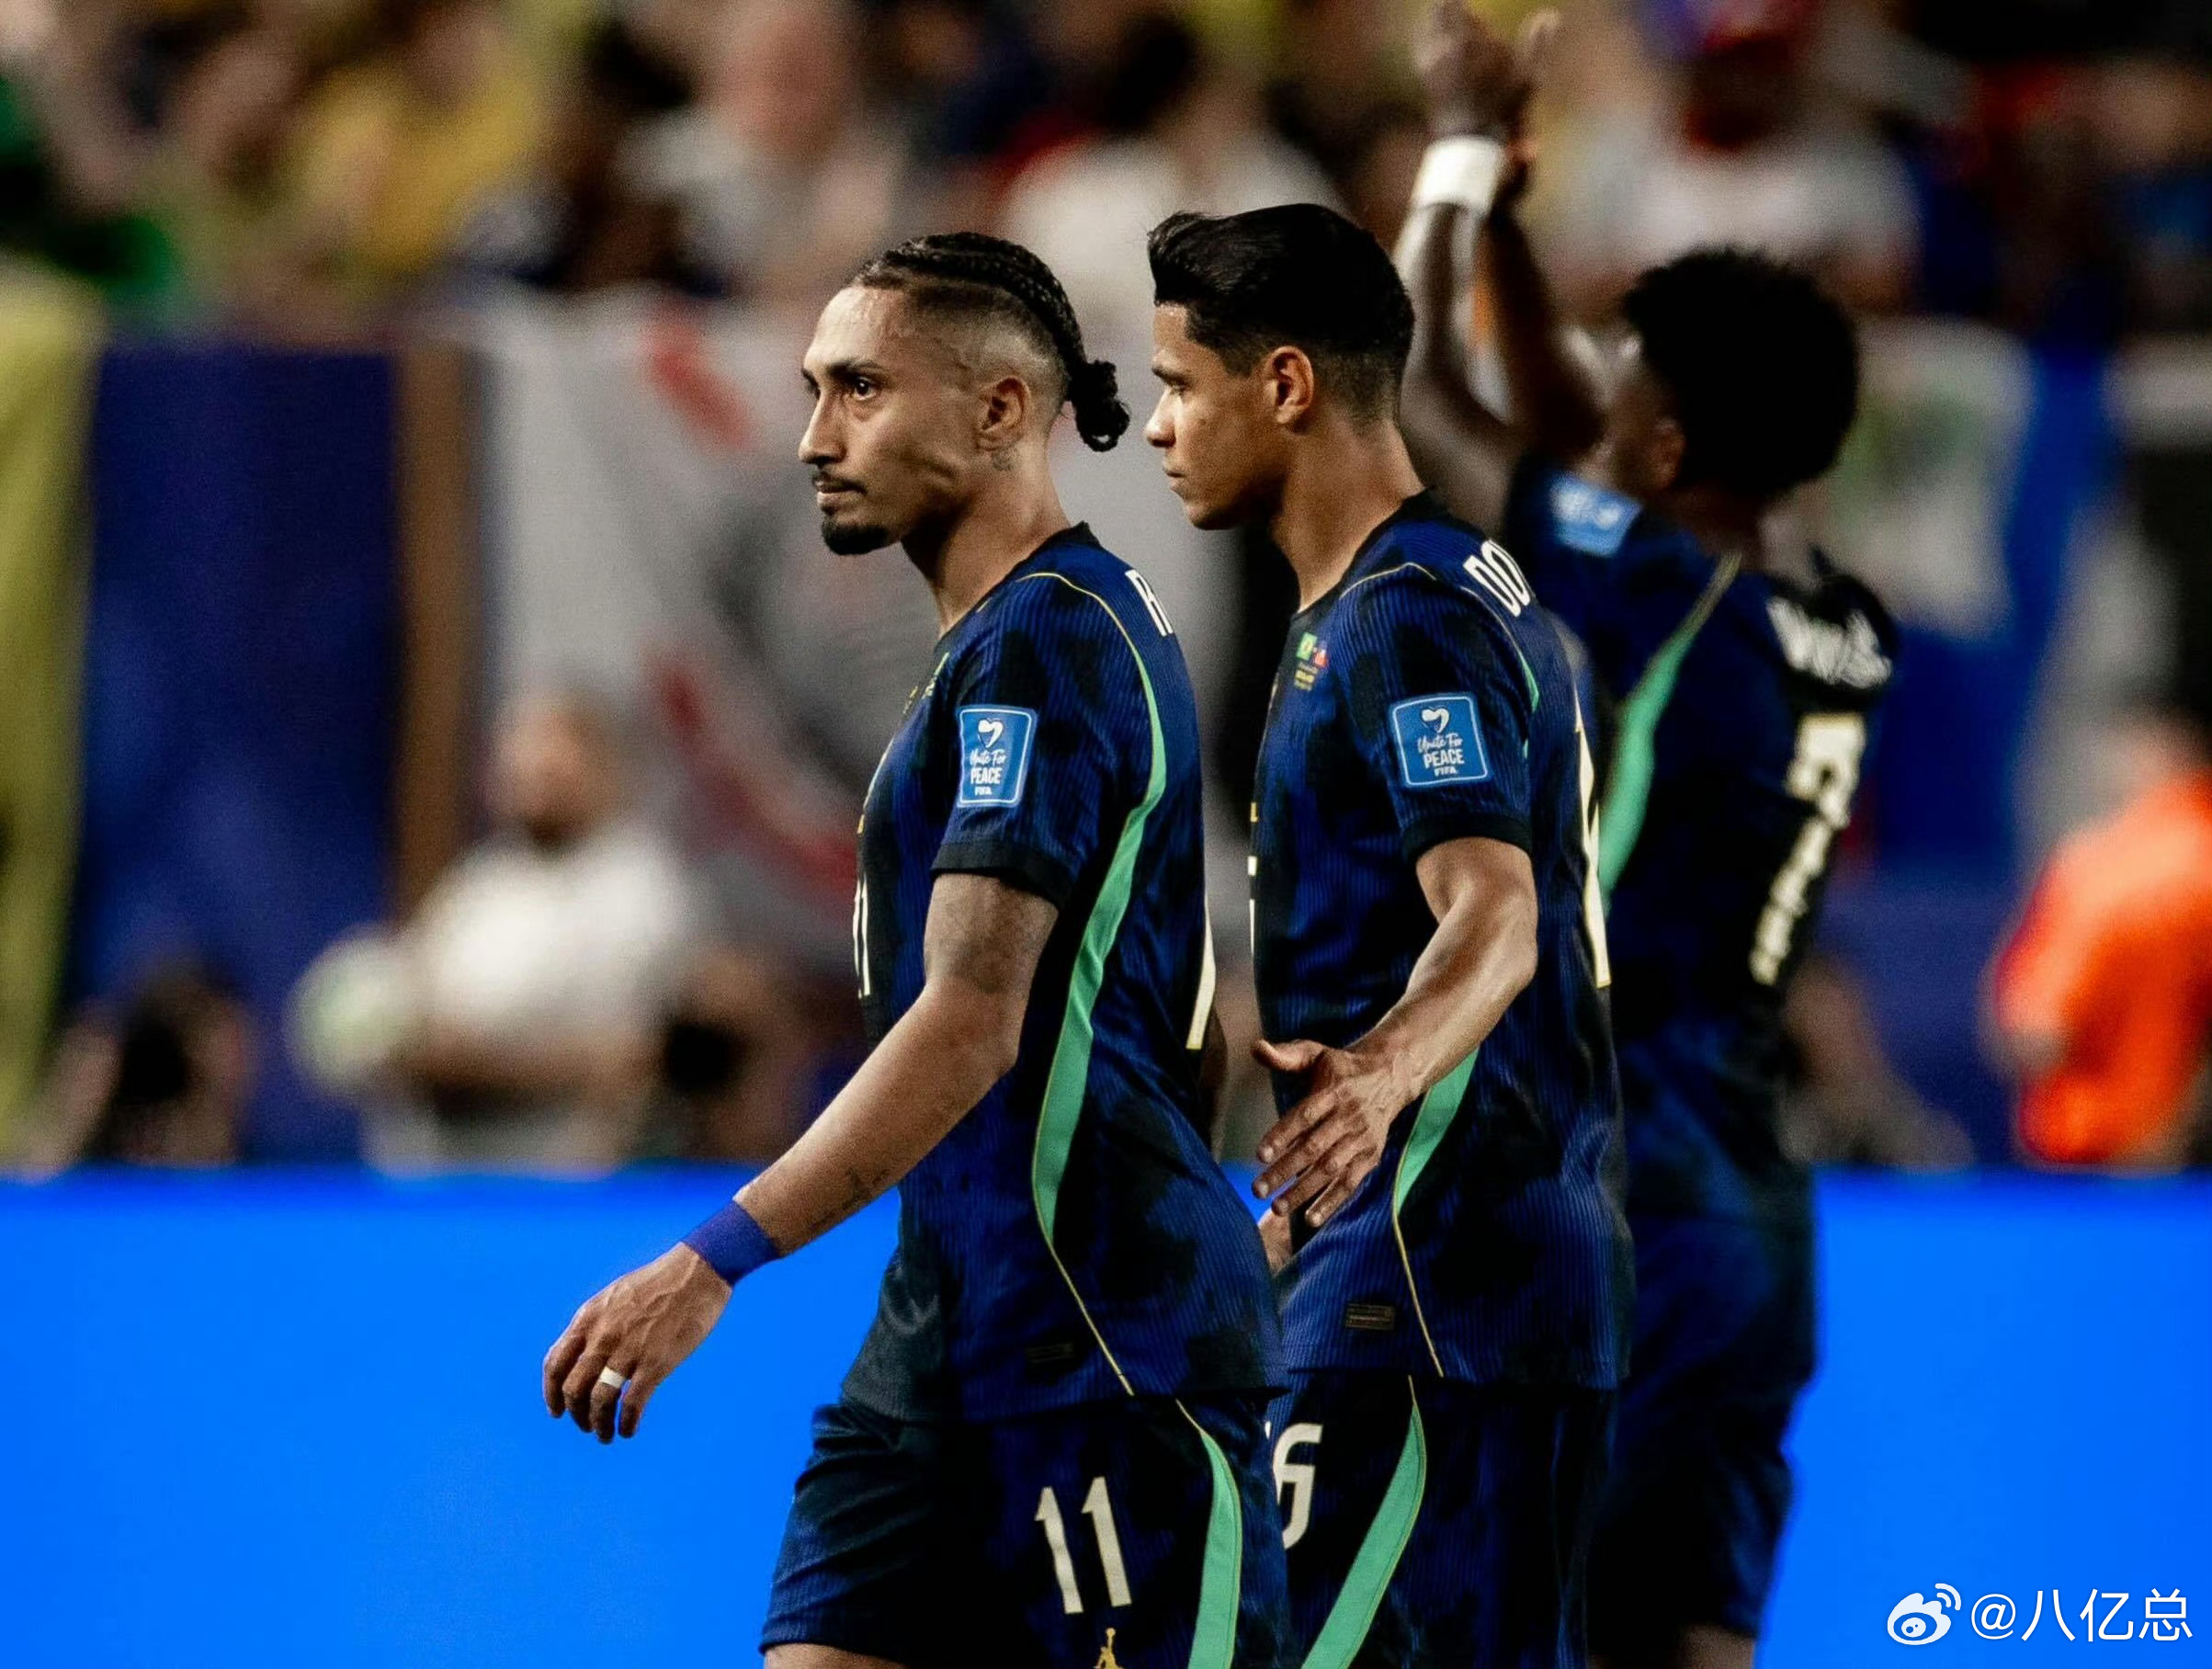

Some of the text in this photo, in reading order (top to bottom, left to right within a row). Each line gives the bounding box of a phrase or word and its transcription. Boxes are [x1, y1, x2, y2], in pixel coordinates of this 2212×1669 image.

[1462, 539, 1531, 618] DO
[1417, 732, 1463, 754] Unite For
[970, 748, 992, 765] Unite
[1423, 748, 1465, 769] PEACE
[970, 766, 1003, 784] PEACE
[1434, 766, 1458, 777] FIFA
[1265, 1421, 1323, 1550] 6
[1034, 1476, 1132, 1615] 11
